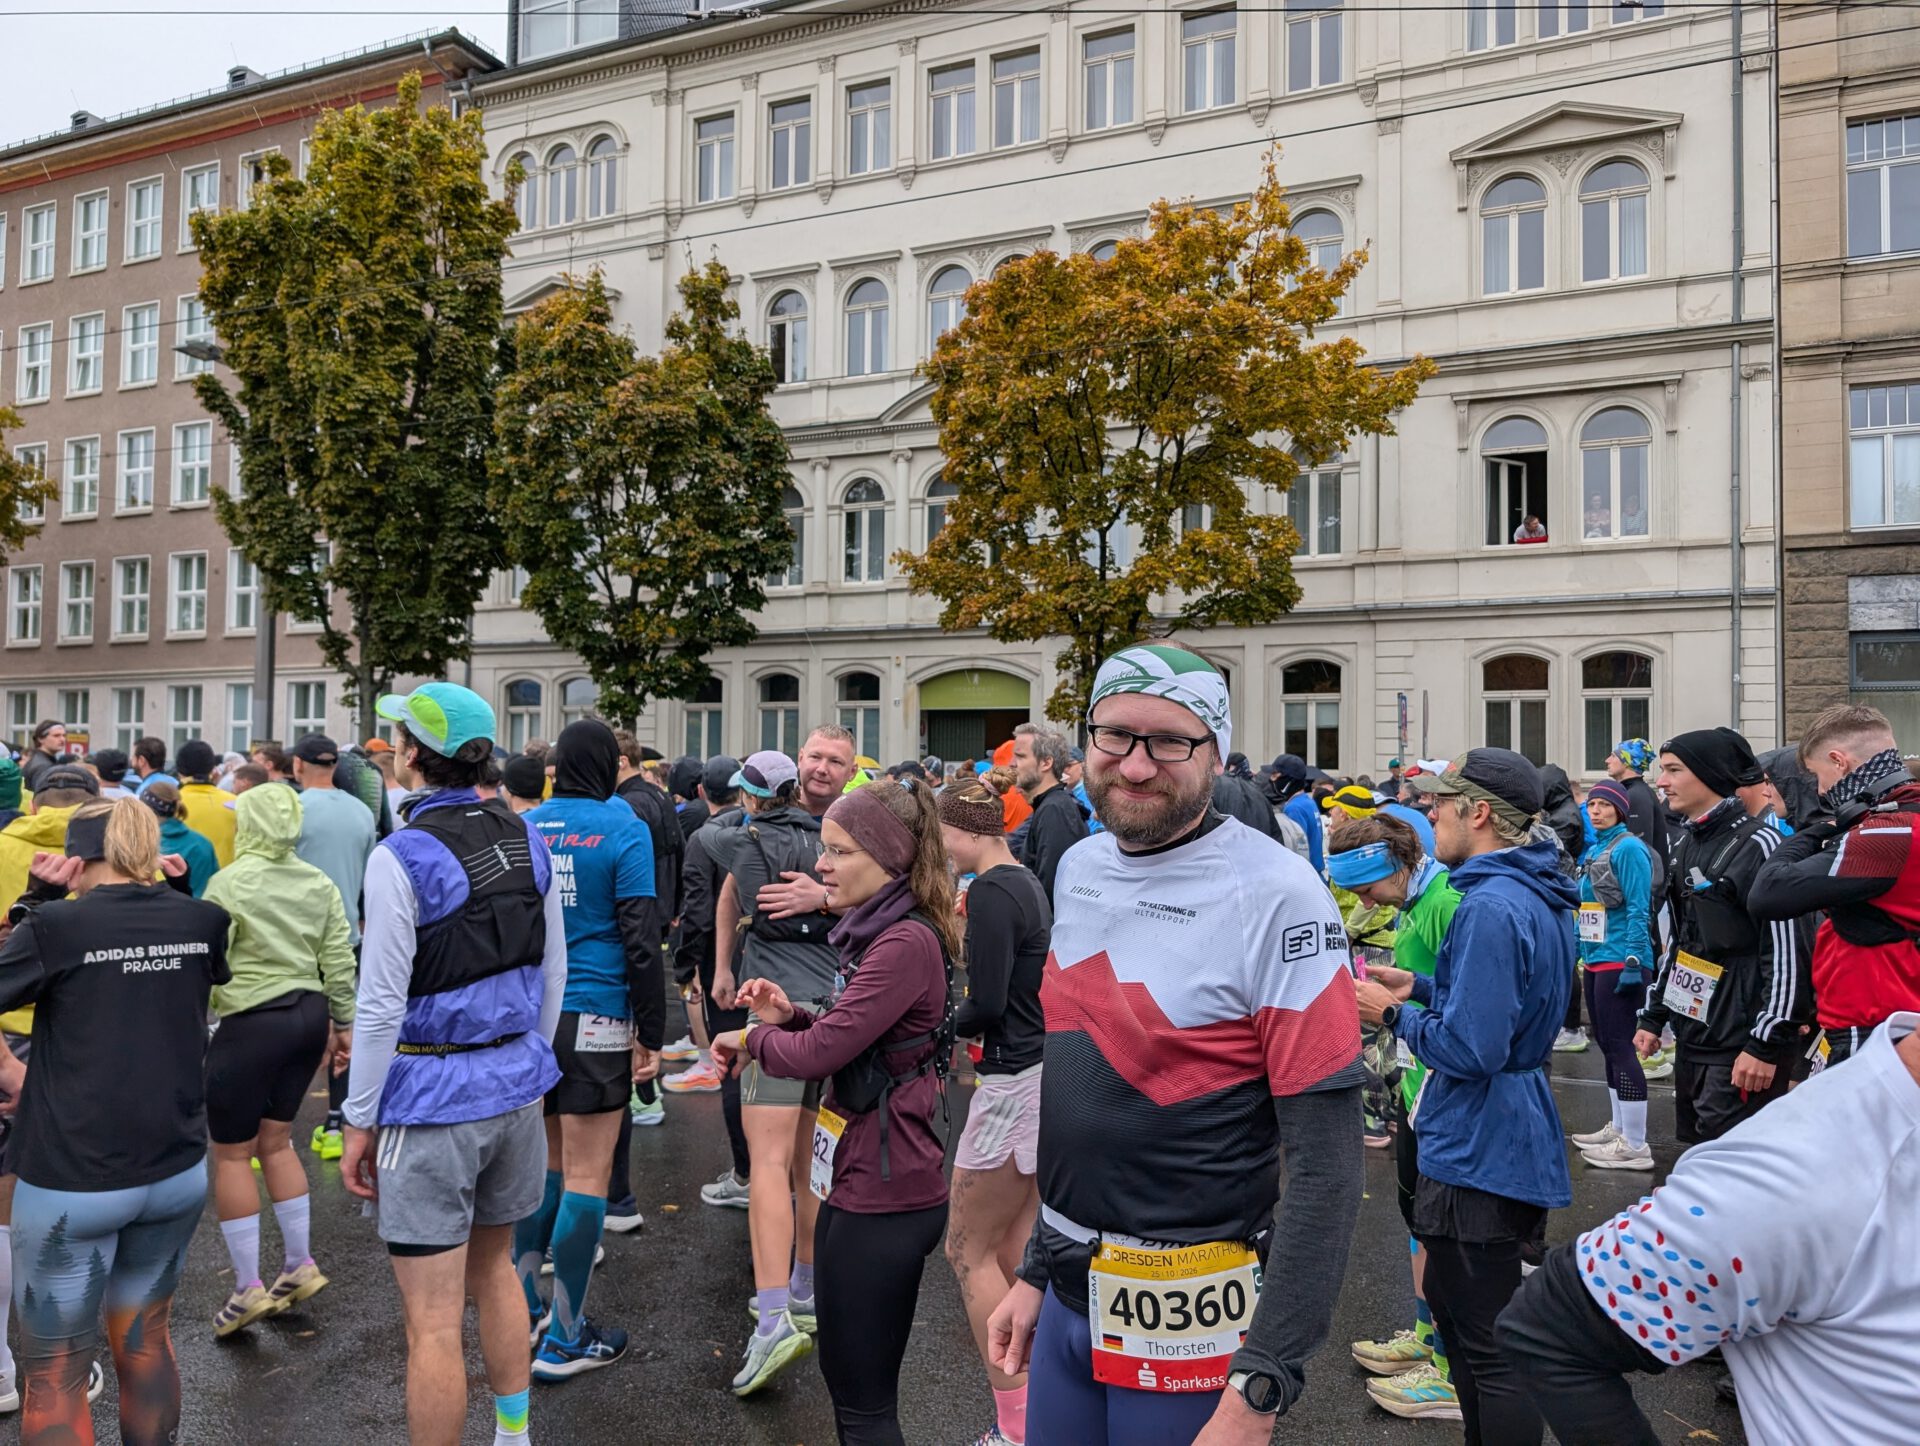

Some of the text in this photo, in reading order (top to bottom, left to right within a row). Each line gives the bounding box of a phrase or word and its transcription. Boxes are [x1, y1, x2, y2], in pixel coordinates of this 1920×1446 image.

[564, 833, 605, 848] FLAT
[1136, 900, 1149, 908] TSV
[1148, 902, 1187, 916] KATZWANG
[1134, 908, 1191, 926] ULTRASPORT
[1580, 912, 1598, 925] 115
[83, 942, 209, 964] ADIDAS RUNNERS
[123, 957, 181, 974] PRAGUE
[1113, 1249, 1173, 1267] DRESDEN
[1109, 1279, 1246, 1331] 40360
[1145, 1341, 1216, 1356] Thorsten
[1163, 1375, 1226, 1392] Sparkass
